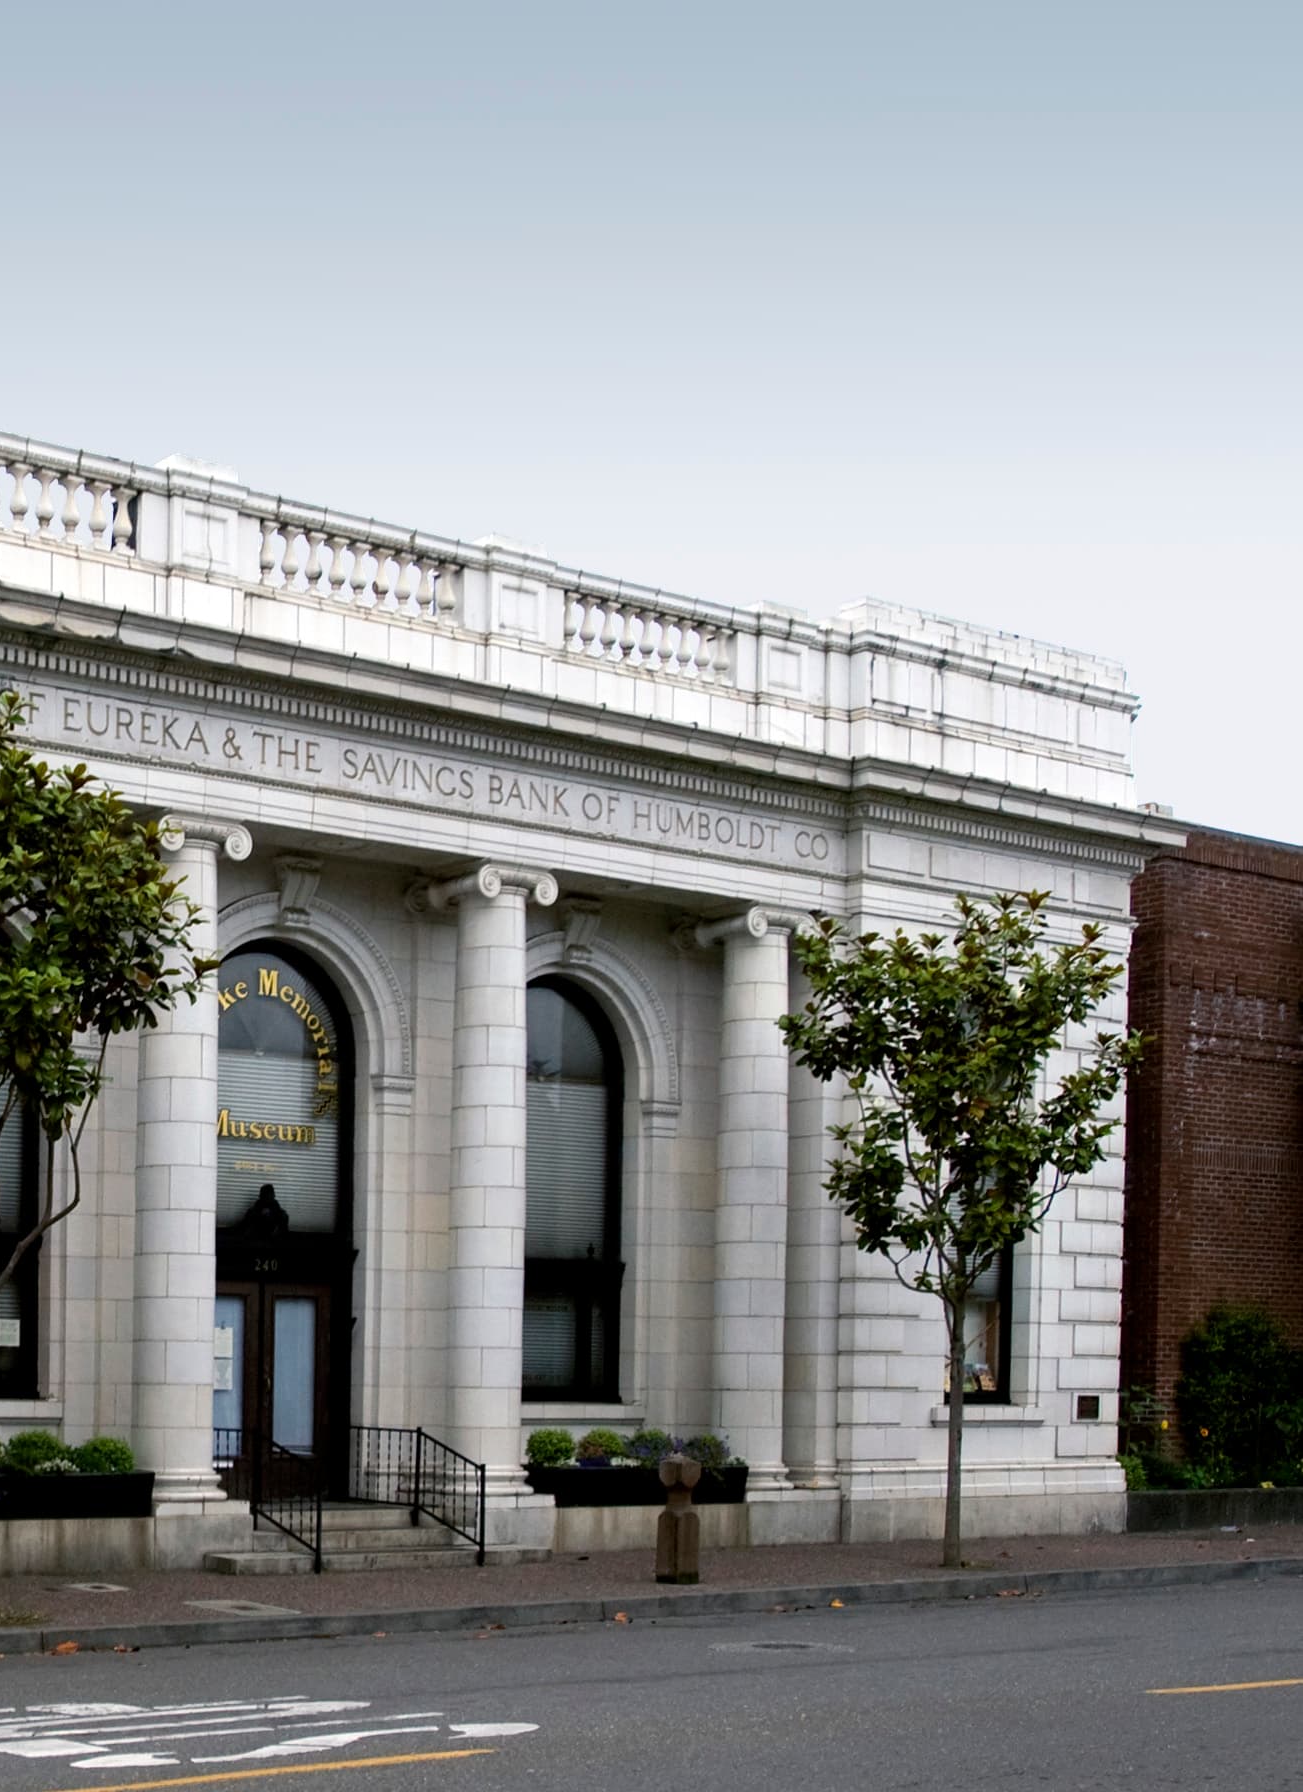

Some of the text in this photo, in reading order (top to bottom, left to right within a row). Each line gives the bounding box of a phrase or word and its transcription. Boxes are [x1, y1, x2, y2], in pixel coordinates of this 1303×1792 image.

[62, 697, 210, 755] EUREKA
[222, 727, 243, 761] &
[252, 731, 323, 773] THE
[342, 749, 474, 800] SAVINGS
[488, 774, 569, 817] BANK
[582, 793, 620, 825] OF
[633, 801, 781, 852] HUMBOLDT
[795, 831, 829, 861] CO
[217, 967, 337, 1091] ke Memorial
[217, 1109, 315, 1143] Museum
[254, 1258, 278, 1271] 240
